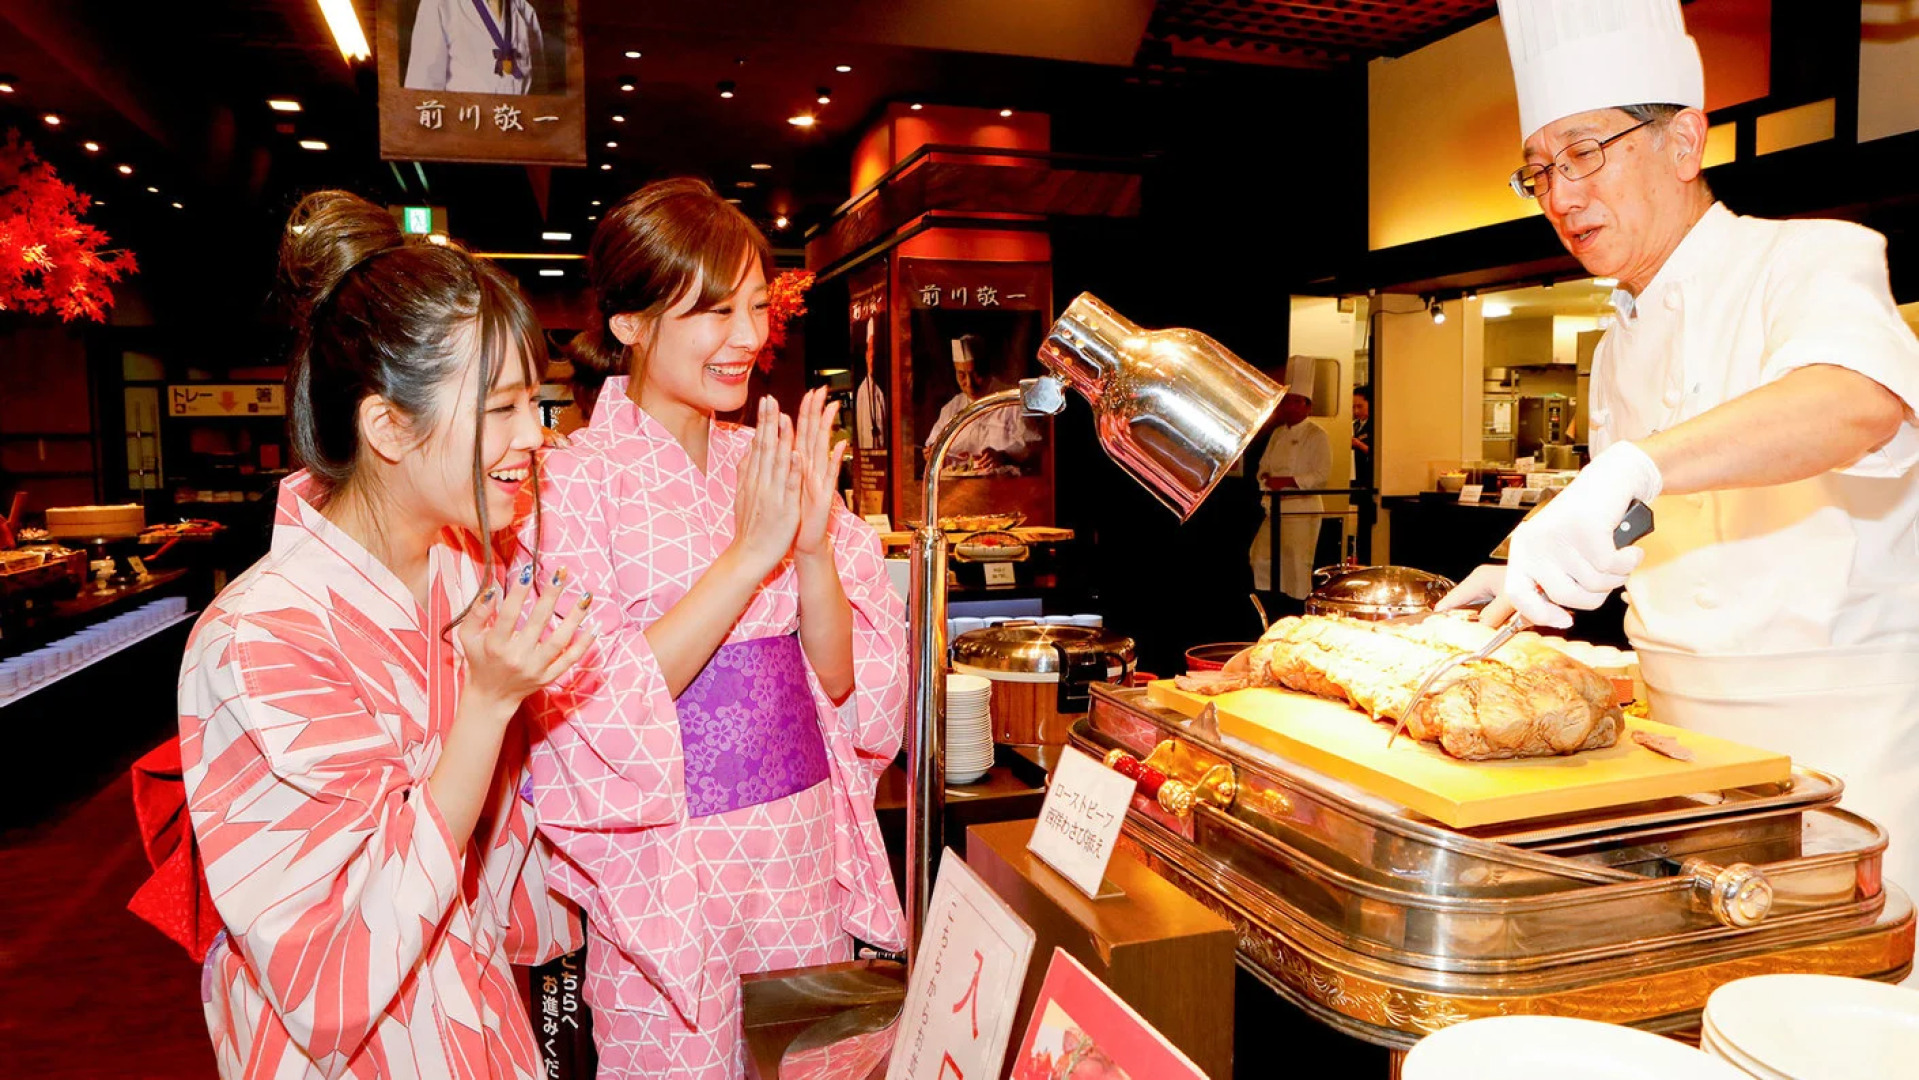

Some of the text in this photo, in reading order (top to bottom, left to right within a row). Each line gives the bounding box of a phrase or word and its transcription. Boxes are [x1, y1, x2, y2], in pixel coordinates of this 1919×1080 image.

[414, 100, 560, 131] 前川敬一
[919, 284, 1027, 307] 前川敬一
[173, 388, 213, 403] トレー
[1054, 783, 1115, 828] ローストビーフ
[542, 974, 560, 1079] お進みくだ
